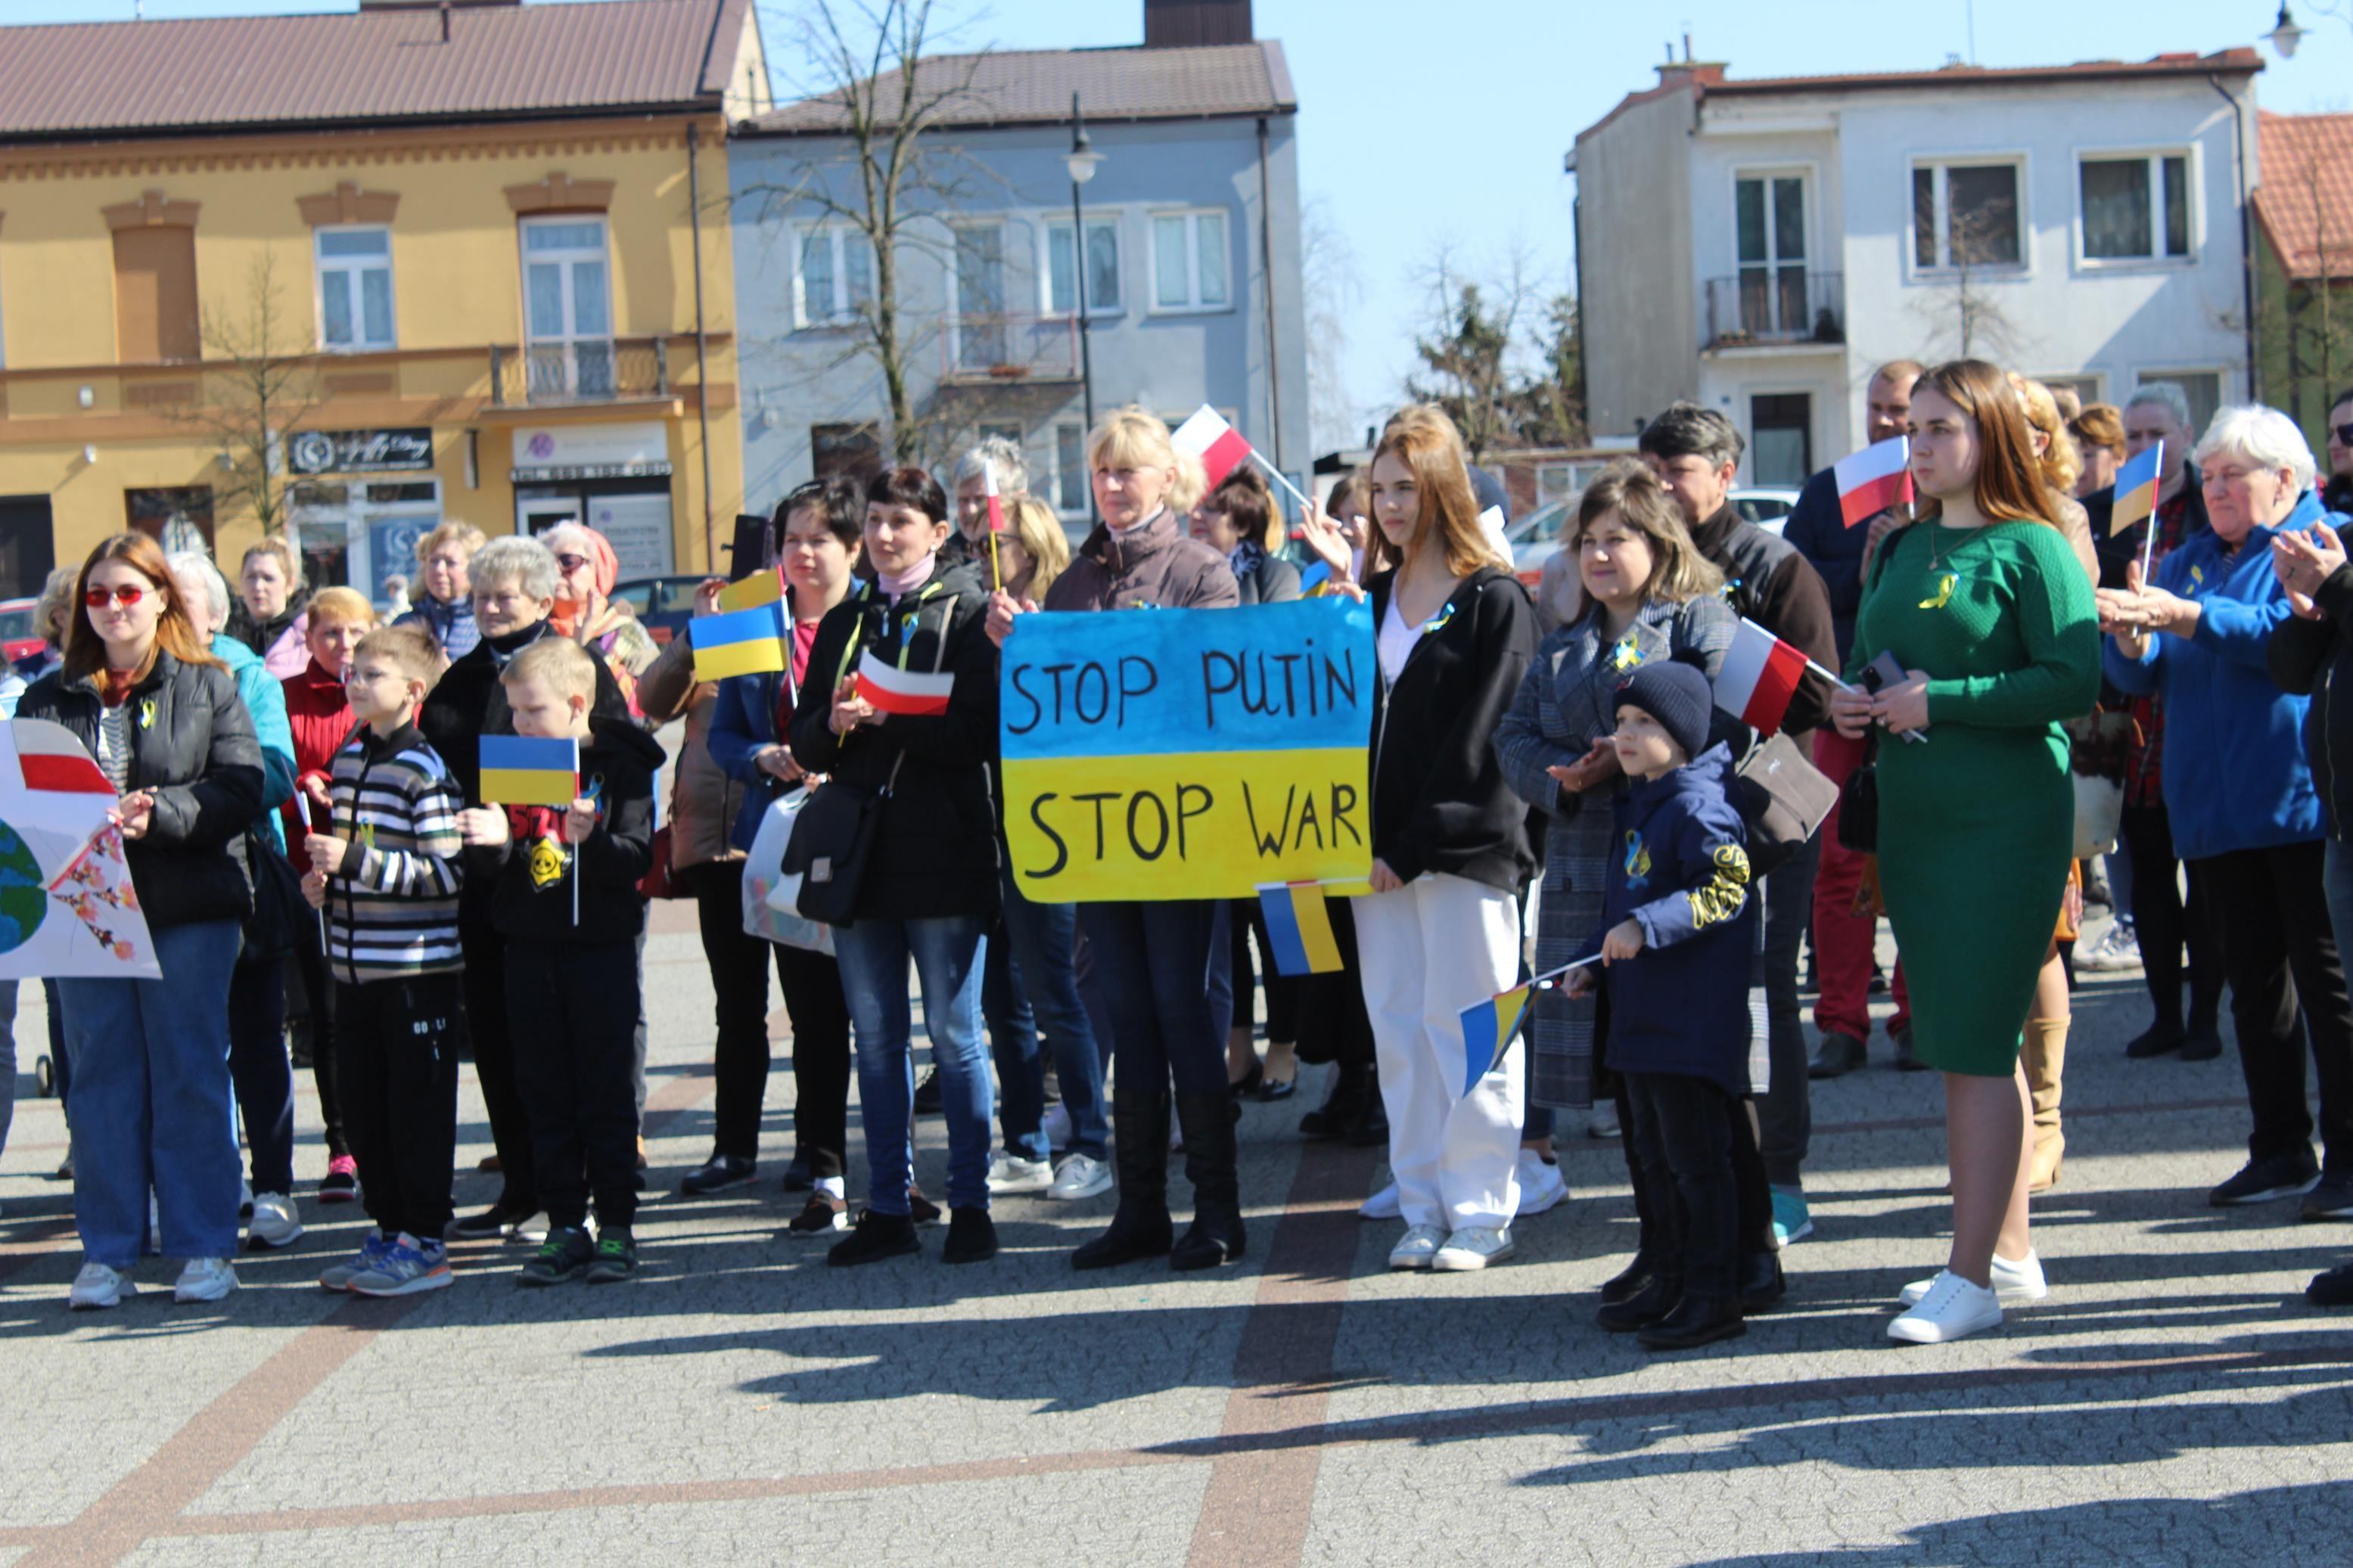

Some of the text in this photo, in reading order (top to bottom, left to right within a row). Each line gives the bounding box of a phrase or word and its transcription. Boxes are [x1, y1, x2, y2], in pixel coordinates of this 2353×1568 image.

[1007, 657, 1158, 734] STOP
[1024, 780, 1362, 878] STOP WAR
